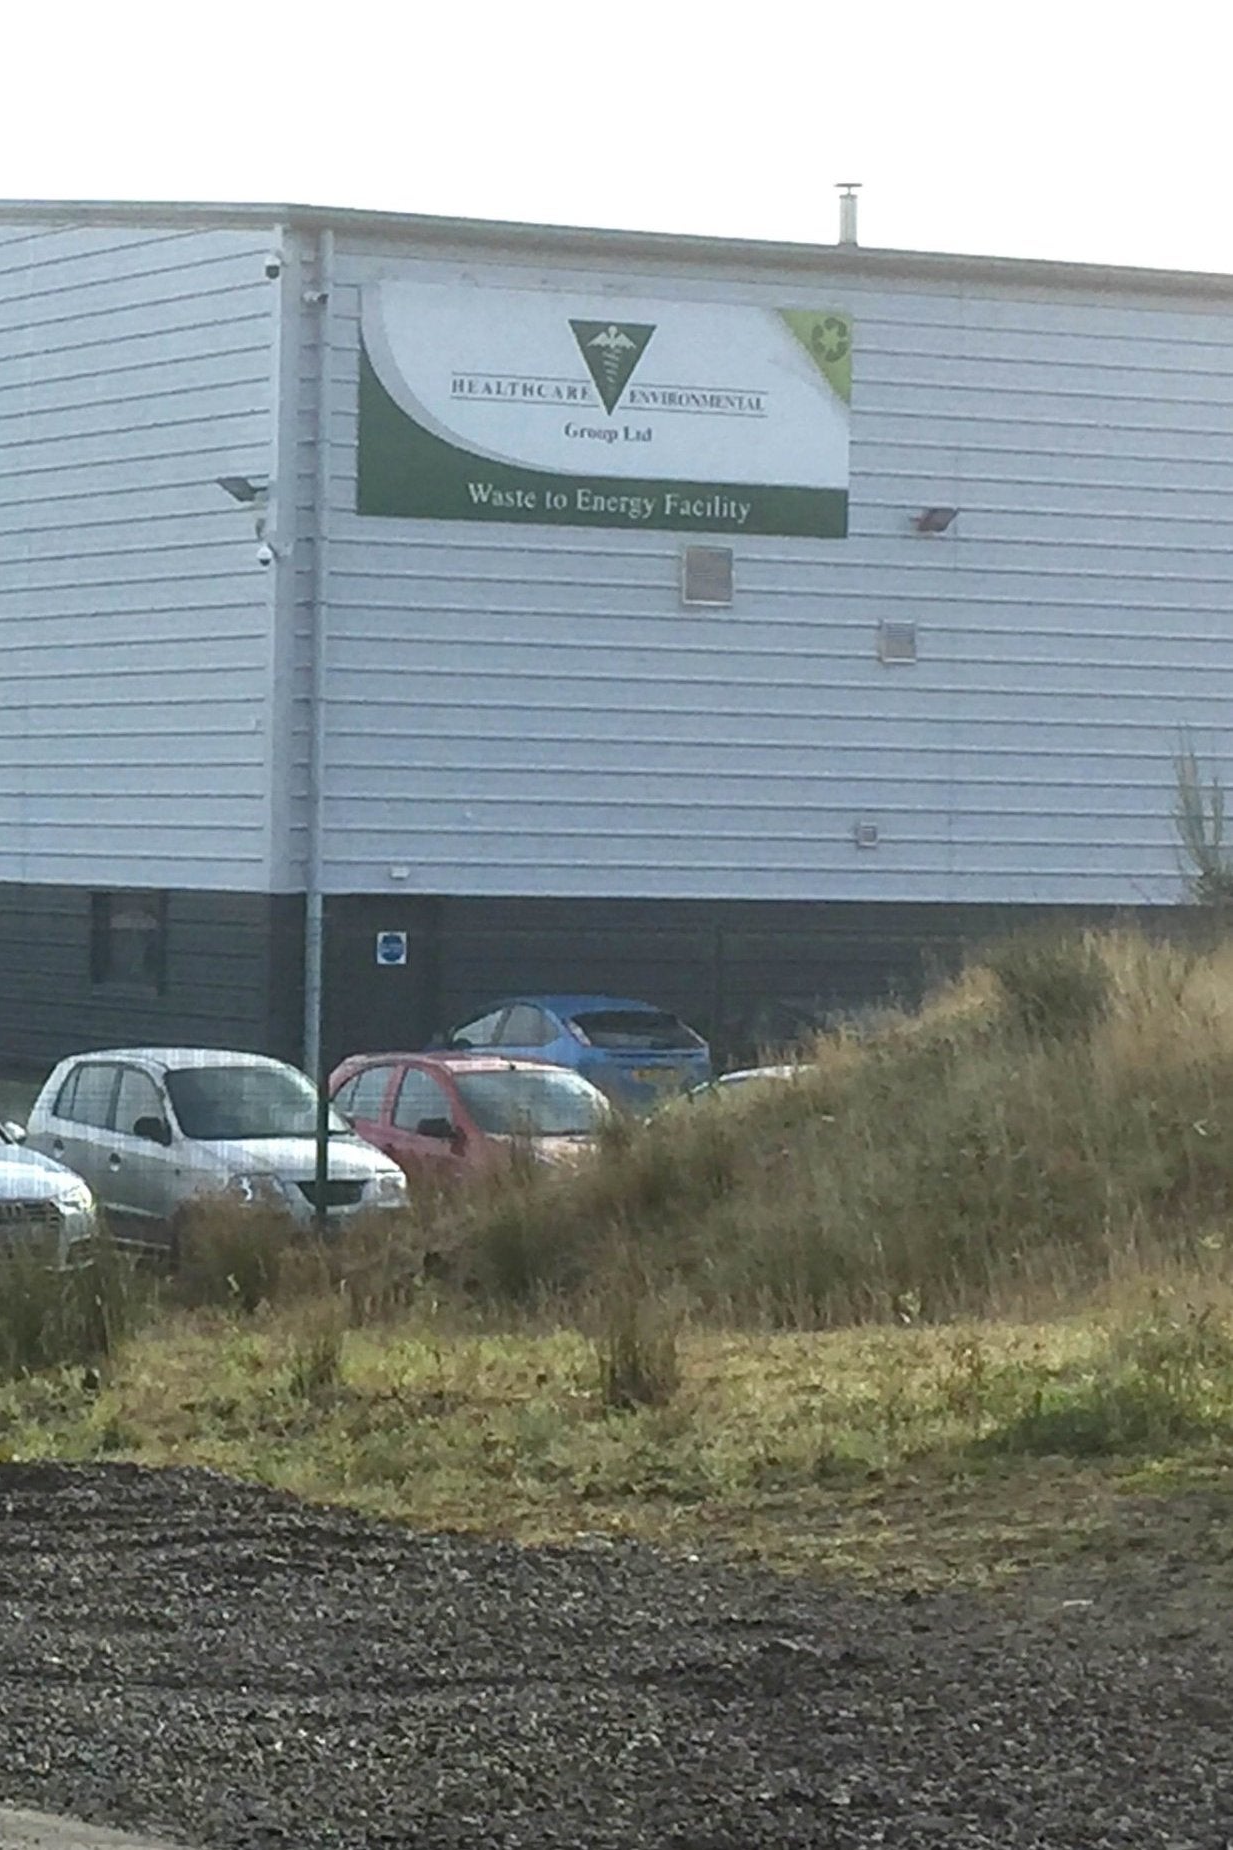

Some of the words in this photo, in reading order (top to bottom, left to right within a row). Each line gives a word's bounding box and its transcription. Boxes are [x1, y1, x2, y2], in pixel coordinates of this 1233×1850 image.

[451, 378, 592, 400] HEALTHCARE
[629, 389, 765, 412] ENVIRONMENTAL
[564, 421, 618, 444] Group
[623, 425, 652, 442] Ltd
[468, 482, 537, 510] Waste
[545, 488, 568, 510] to
[576, 488, 656, 519] Energy
[664, 493, 751, 524] Facility
